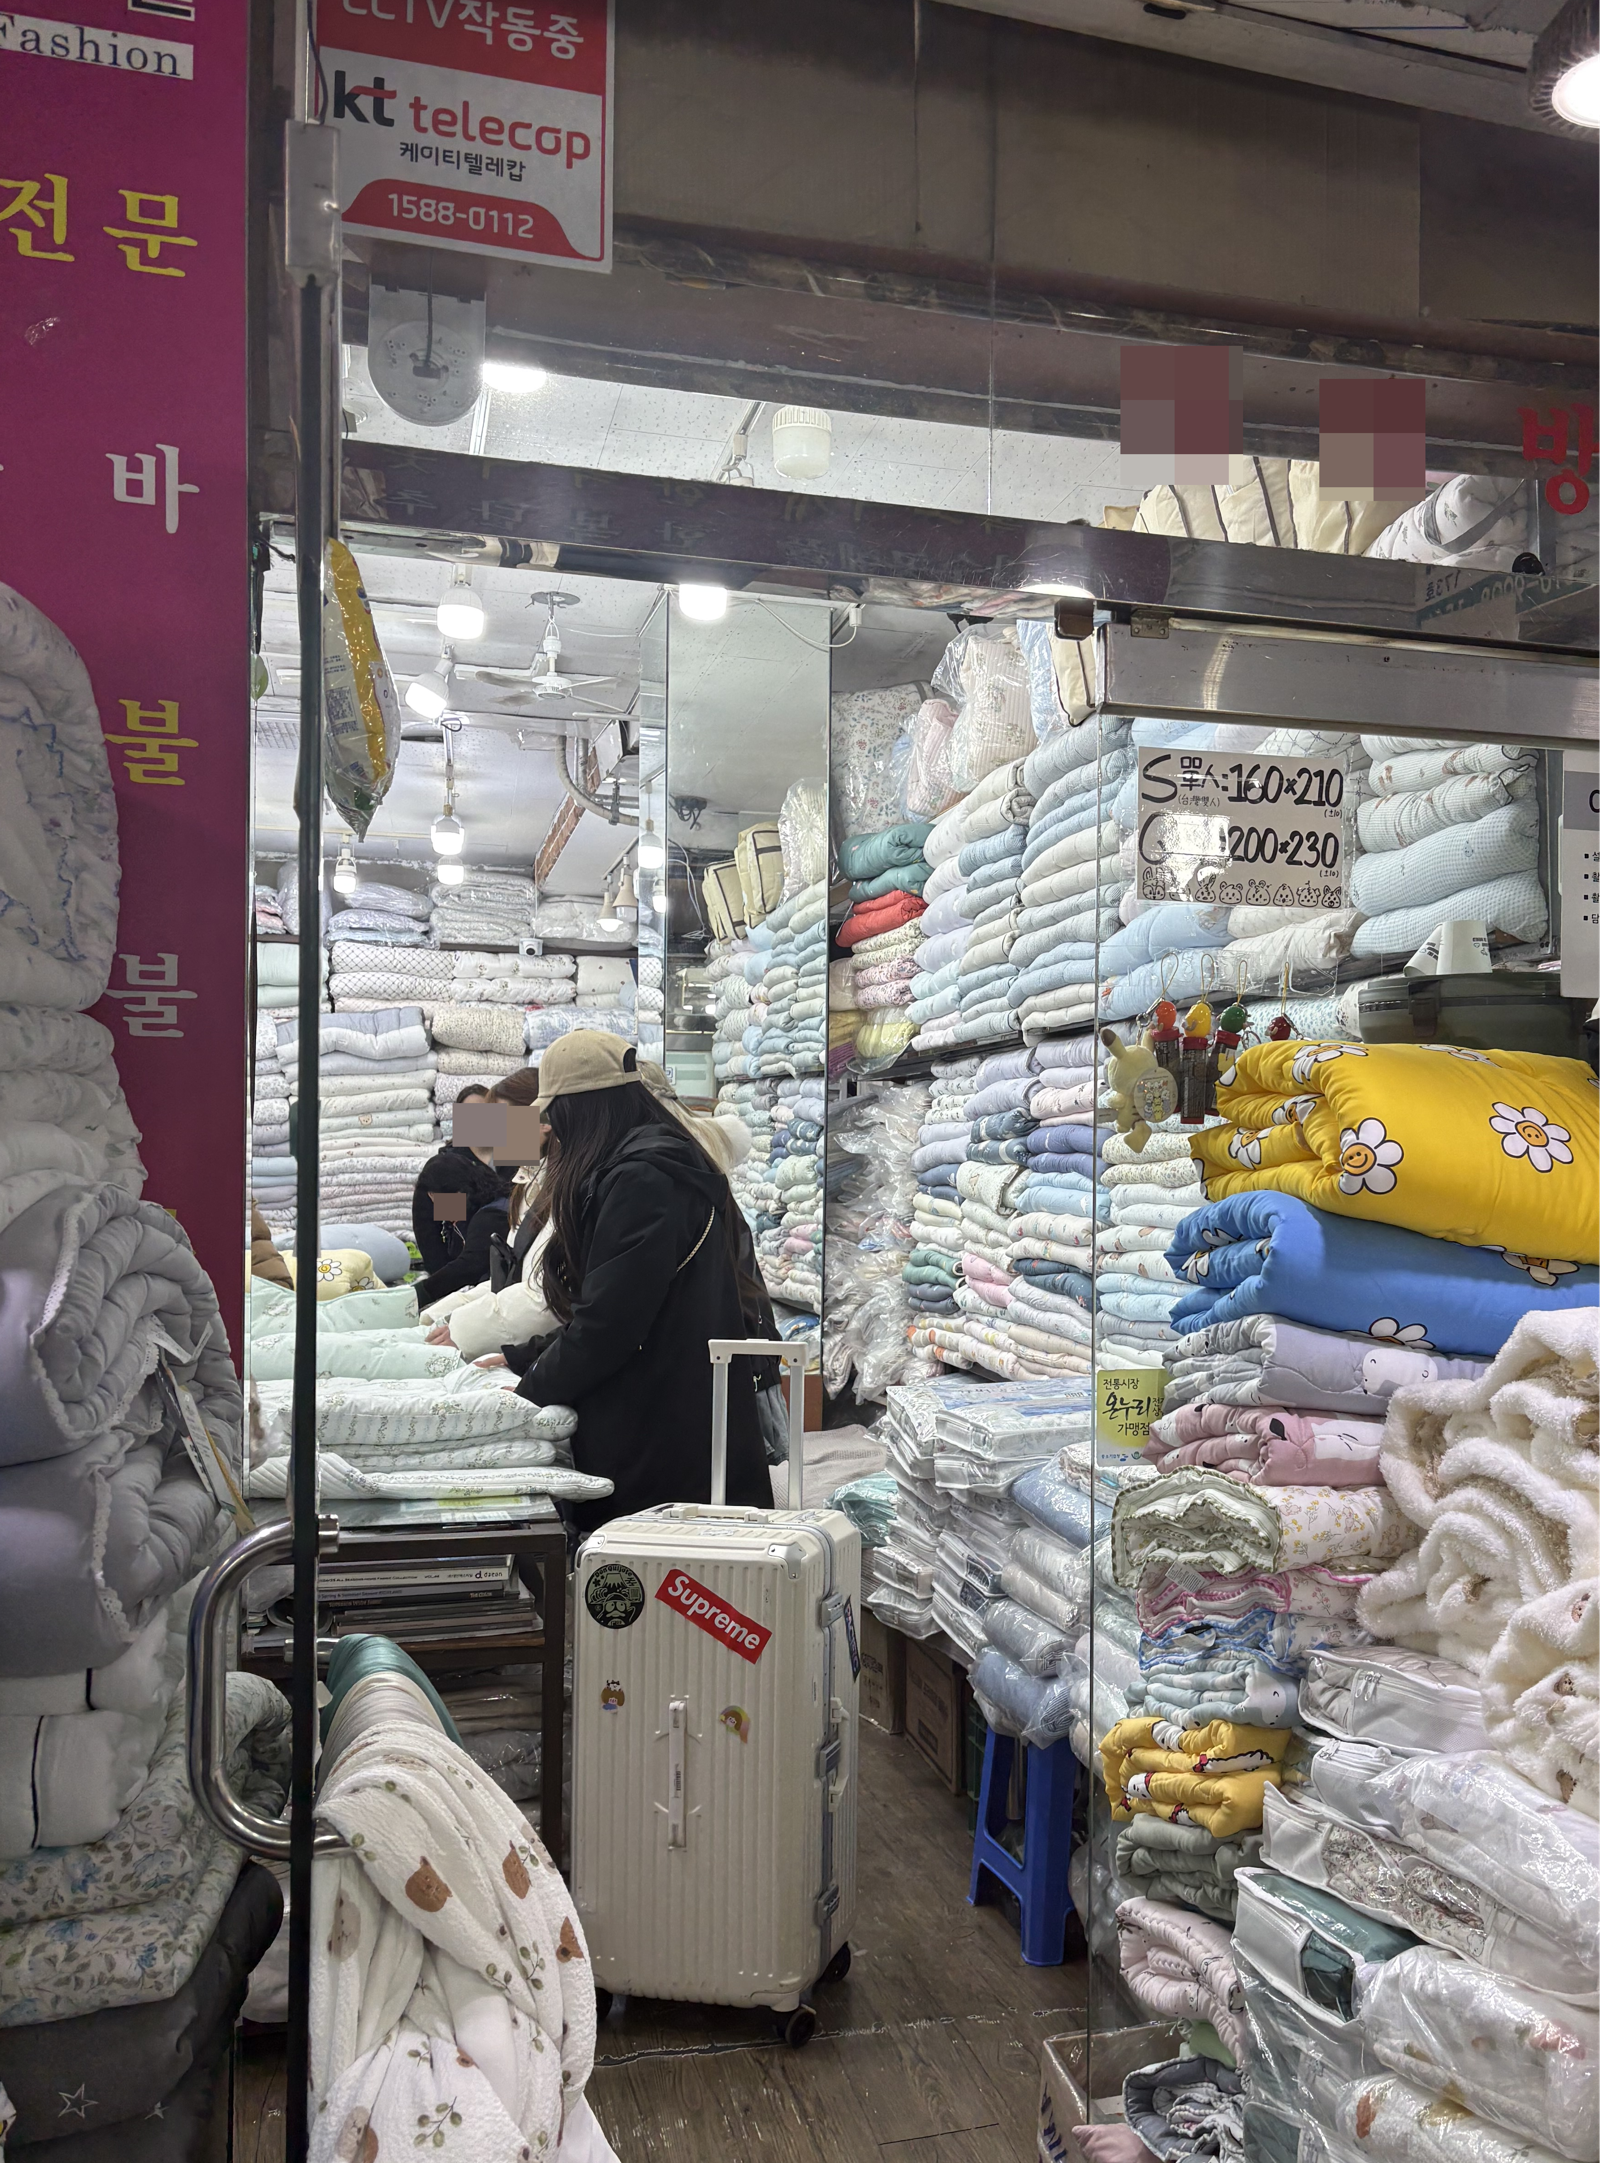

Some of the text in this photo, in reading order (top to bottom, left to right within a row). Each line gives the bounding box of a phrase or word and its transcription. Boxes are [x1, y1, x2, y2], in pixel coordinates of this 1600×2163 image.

[333, 69, 591, 169] kt telecop
[399, 141, 526, 182] 케이티텔레캅
[388, 193, 534, 239] 1588-0112
[1103, 1378, 1139, 1390] 전통시장
[1117, 1422, 1150, 1436] 가맹점
[667, 1575, 761, 1650] Supreme
